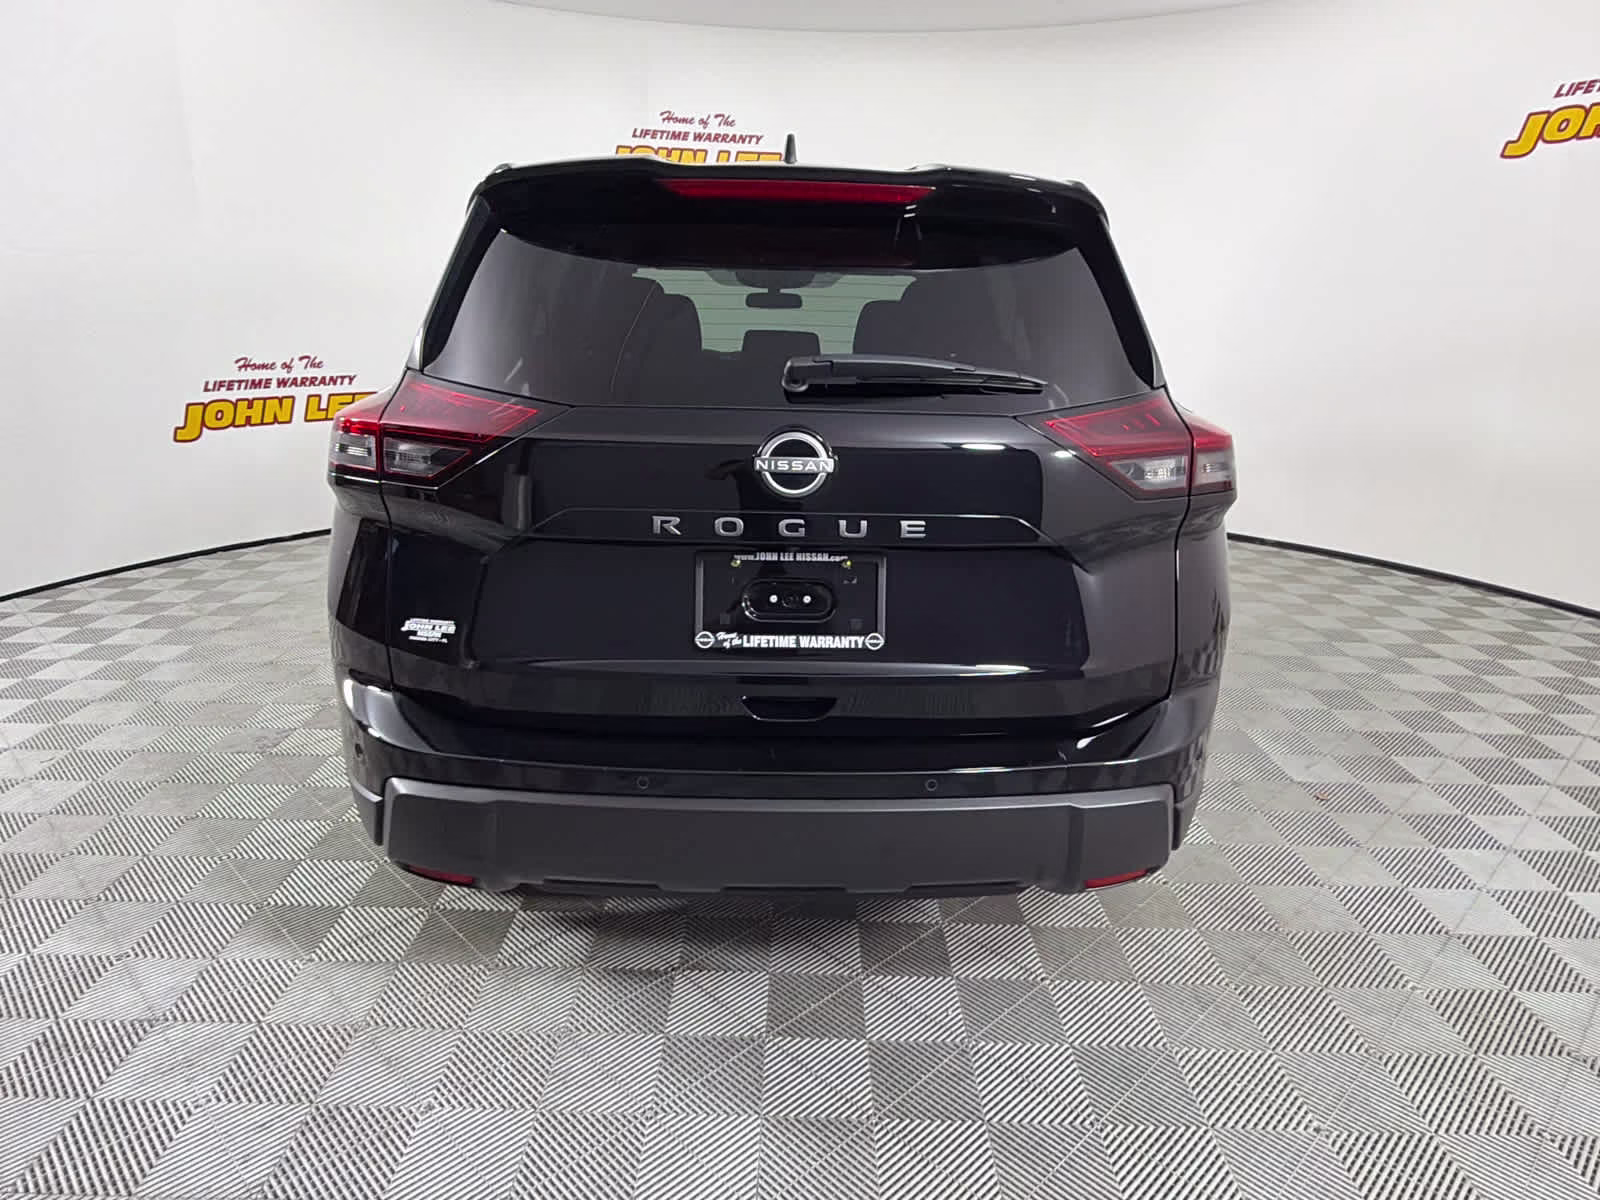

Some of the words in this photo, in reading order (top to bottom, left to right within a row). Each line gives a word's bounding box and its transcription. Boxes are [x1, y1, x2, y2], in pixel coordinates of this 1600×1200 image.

[660, 110, 695, 125] Home
[698, 114, 710, 129] of
[714, 113, 736, 128] The
[632, 128, 690, 142] LIFETIME
[693, 131, 763, 145] WARRANTY
[235, 357, 277, 371] Home
[280, 358, 294, 373] of
[299, 355, 323, 369] The
[203, 377, 272, 393] LIFETIME
[276, 374, 357, 388] WARRANTY
[173, 395, 296, 443] JOHN
[304, 391, 378, 422] LE
[755, 459, 834, 473] NISSAN
[652, 515, 926, 538] ROGUE
[780, 552, 794, 561] LEE
[742, 634, 797, 648] LIFETIME
[799, 635, 865, 649] WARRANTY
